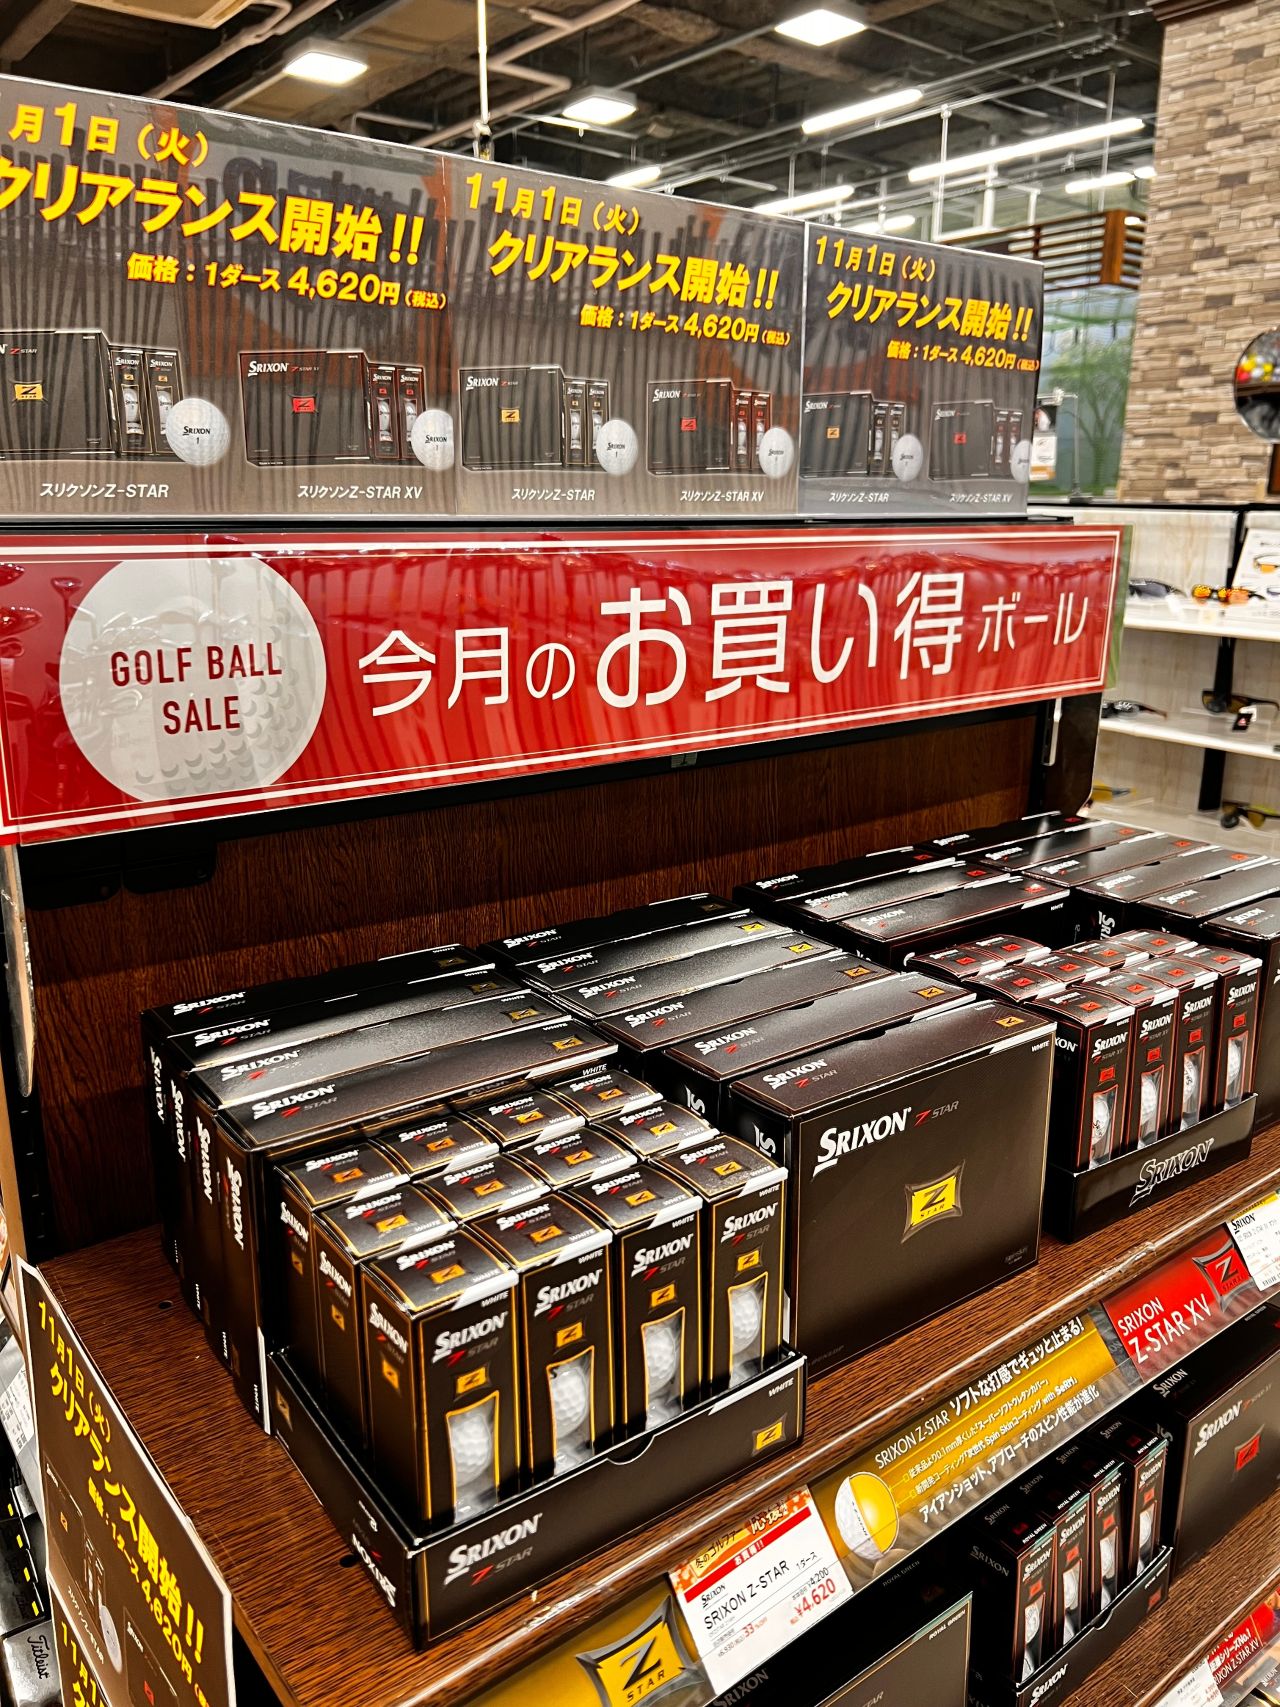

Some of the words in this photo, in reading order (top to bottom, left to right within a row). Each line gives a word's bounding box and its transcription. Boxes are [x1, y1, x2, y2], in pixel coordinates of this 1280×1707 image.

[248, 360, 289, 377] SRIXON
[465, 375, 499, 391] SRIXON
[652, 388, 681, 403] SRIXON
[182, 425, 211, 436] SRIXON
[425, 434, 448, 443] SRIXON
[40, 482, 170, 498] スリクソンZ-STAR
[404, 485, 423, 499] XV
[751, 491, 765, 502] XV
[110, 646, 192, 688] GOLF
[207, 642, 284, 680] BALL
[162, 695, 241, 736] SALE
[502, 928, 557, 949] SRIXON
[537, 952, 593, 974] SRIXON
[578, 975, 637, 999] SRIXON
[1227, 982, 1257, 1006] SRIXON
[173, 991, 246, 1016] SRIXON
[624, 1001, 685, 1028] SRIXON
[1182, 996, 1213, 1021] SRIXON
[194, 1019, 271, 1047] SRIXON
[1140, 1013, 1174, 1039] SRIXON
[694, 1027, 758, 1056] SRIXON
[1031, 1040, 1050, 1053] WHITE
[1091, 1032, 1129, 1059] SRIXON
[220, 1050, 300, 1081] SRIXON
[582, 1063, 608, 1077] WHITE
[763, 1058, 828, 1090] SRIXON
[811, 1069, 838, 1082] STAR
[569, 1073, 612, 1091] SRIXON
[252, 1084, 335, 1120] SRIXON
[488, 1096, 533, 1116] SRIXON
[170, 1079, 187, 1163] SRIXON
[619, 1106, 663, 1126] SRIXON
[399, 1121, 448, 1142] SRIXON
[534, 1133, 581, 1155] SRIXON
[811, 1106, 913, 1182] SRIXON
[931, 1100, 960, 1120] STAR
[195, 1115, 213, 1205] SRIXON
[305, 1149, 359, 1172] SRIXON
[680, 1142, 726, 1165] SRIXON
[443, 1162, 495, 1186] SRIXON
[591, 1171, 641, 1196] SRIXON
[1129, 1138, 1215, 1207] SRIXON
[226, 1155, 245, 1252] SRIXON
[758, 1184, 780, 1198] WHITE
[919, 1183, 949, 1212] Z
[346, 1192, 403, 1220] SRIXON
[497, 1203, 550, 1231] SRIXON
[919, 1203, 946, 1218] STAR
[671, 1213, 695, 1228] WHITE
[721, 1202, 779, 1245] SRIXON
[1231, 1213, 1256, 1235] SRIXON
[396, 1240, 456, 1271] SRIXON
[578, 1248, 604, 1264] WHITE
[630, 1233, 694, 1278] SRIXON
[481, 1291, 509, 1308] WHITE
[534, 1268, 603, 1317] SRIXON
[369, 1302, 409, 1354] SRIXON
[1117, 1296, 1164, 1336] SRIXON
[1128, 1310, 1185, 1364] Z-STAR
[1184, 1293, 1212, 1323] XV
[432, 1310, 508, 1364] SRIXON
[767, 1377, 795, 1398] WHITE
[1152, 1368, 1189, 1398] SRIXON
[874, 1432, 918, 1470] SRIXON
[915, 1410, 952, 1442] Z-STAR
[984, 1429, 1001, 1446] Spin
[1194, 1400, 1243, 1458] SRIXON
[443, 1513, 544, 1586] SRIXON
[494, 1546, 533, 1573] STAR
[970, 1545, 1010, 1577] SRIXON
[701, 1584, 726, 1609] SRIXON
[704, 1591, 747, 1630] SRIXON
[747, 1559, 790, 1598] Z-STAR
[796, 1578, 836, 1617] ¥4,620
[27, 1634, 51, 1682] Titleist
[61, 1620, 97, 1706] 11月1
[619, 1635, 661, 1691] Z
[626, 1670, 666, 1702] STAR
[712, 1669, 770, 1707] SRIXON
[1029, 1663, 1069, 1707] SRIXON
